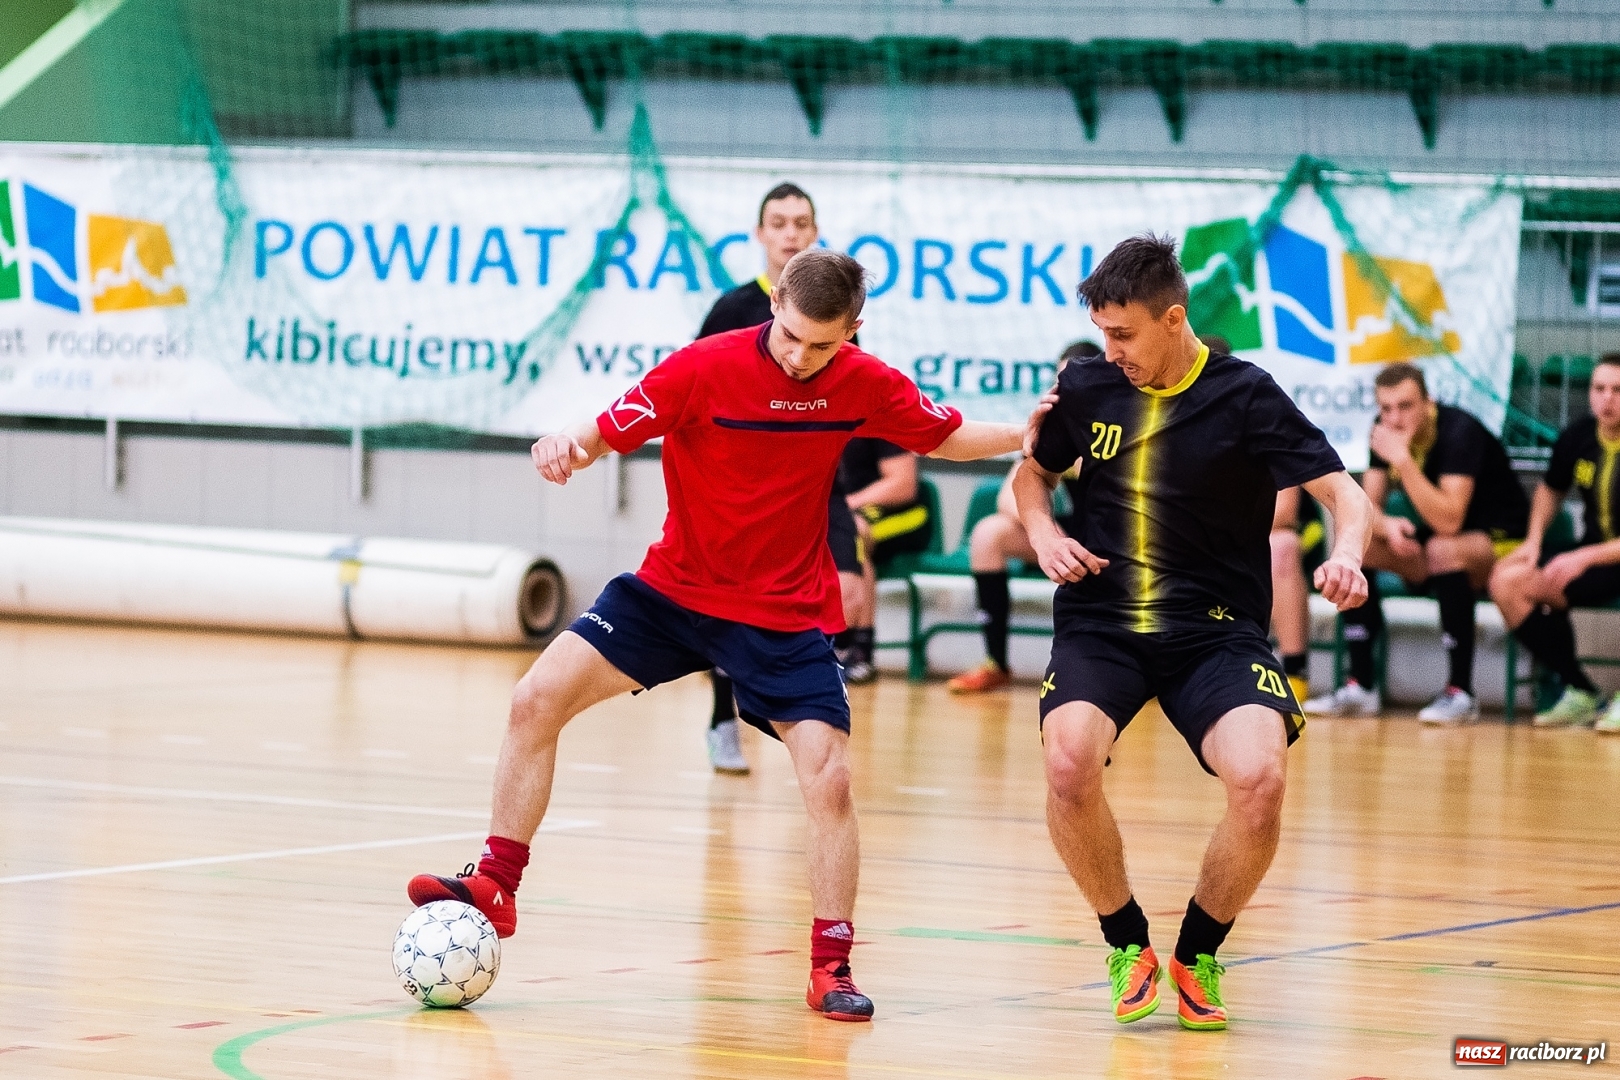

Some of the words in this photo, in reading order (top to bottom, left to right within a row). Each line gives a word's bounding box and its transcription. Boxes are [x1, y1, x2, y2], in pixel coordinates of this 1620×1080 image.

[254, 218, 567, 287] POWIAT
[596, 228, 1092, 305] RACORSKI
[245, 316, 540, 385] kibicujemy,
[770, 399, 827, 411] GIVOVA
[1090, 421, 1123, 460] 20
[1251, 663, 1287, 699] 20
